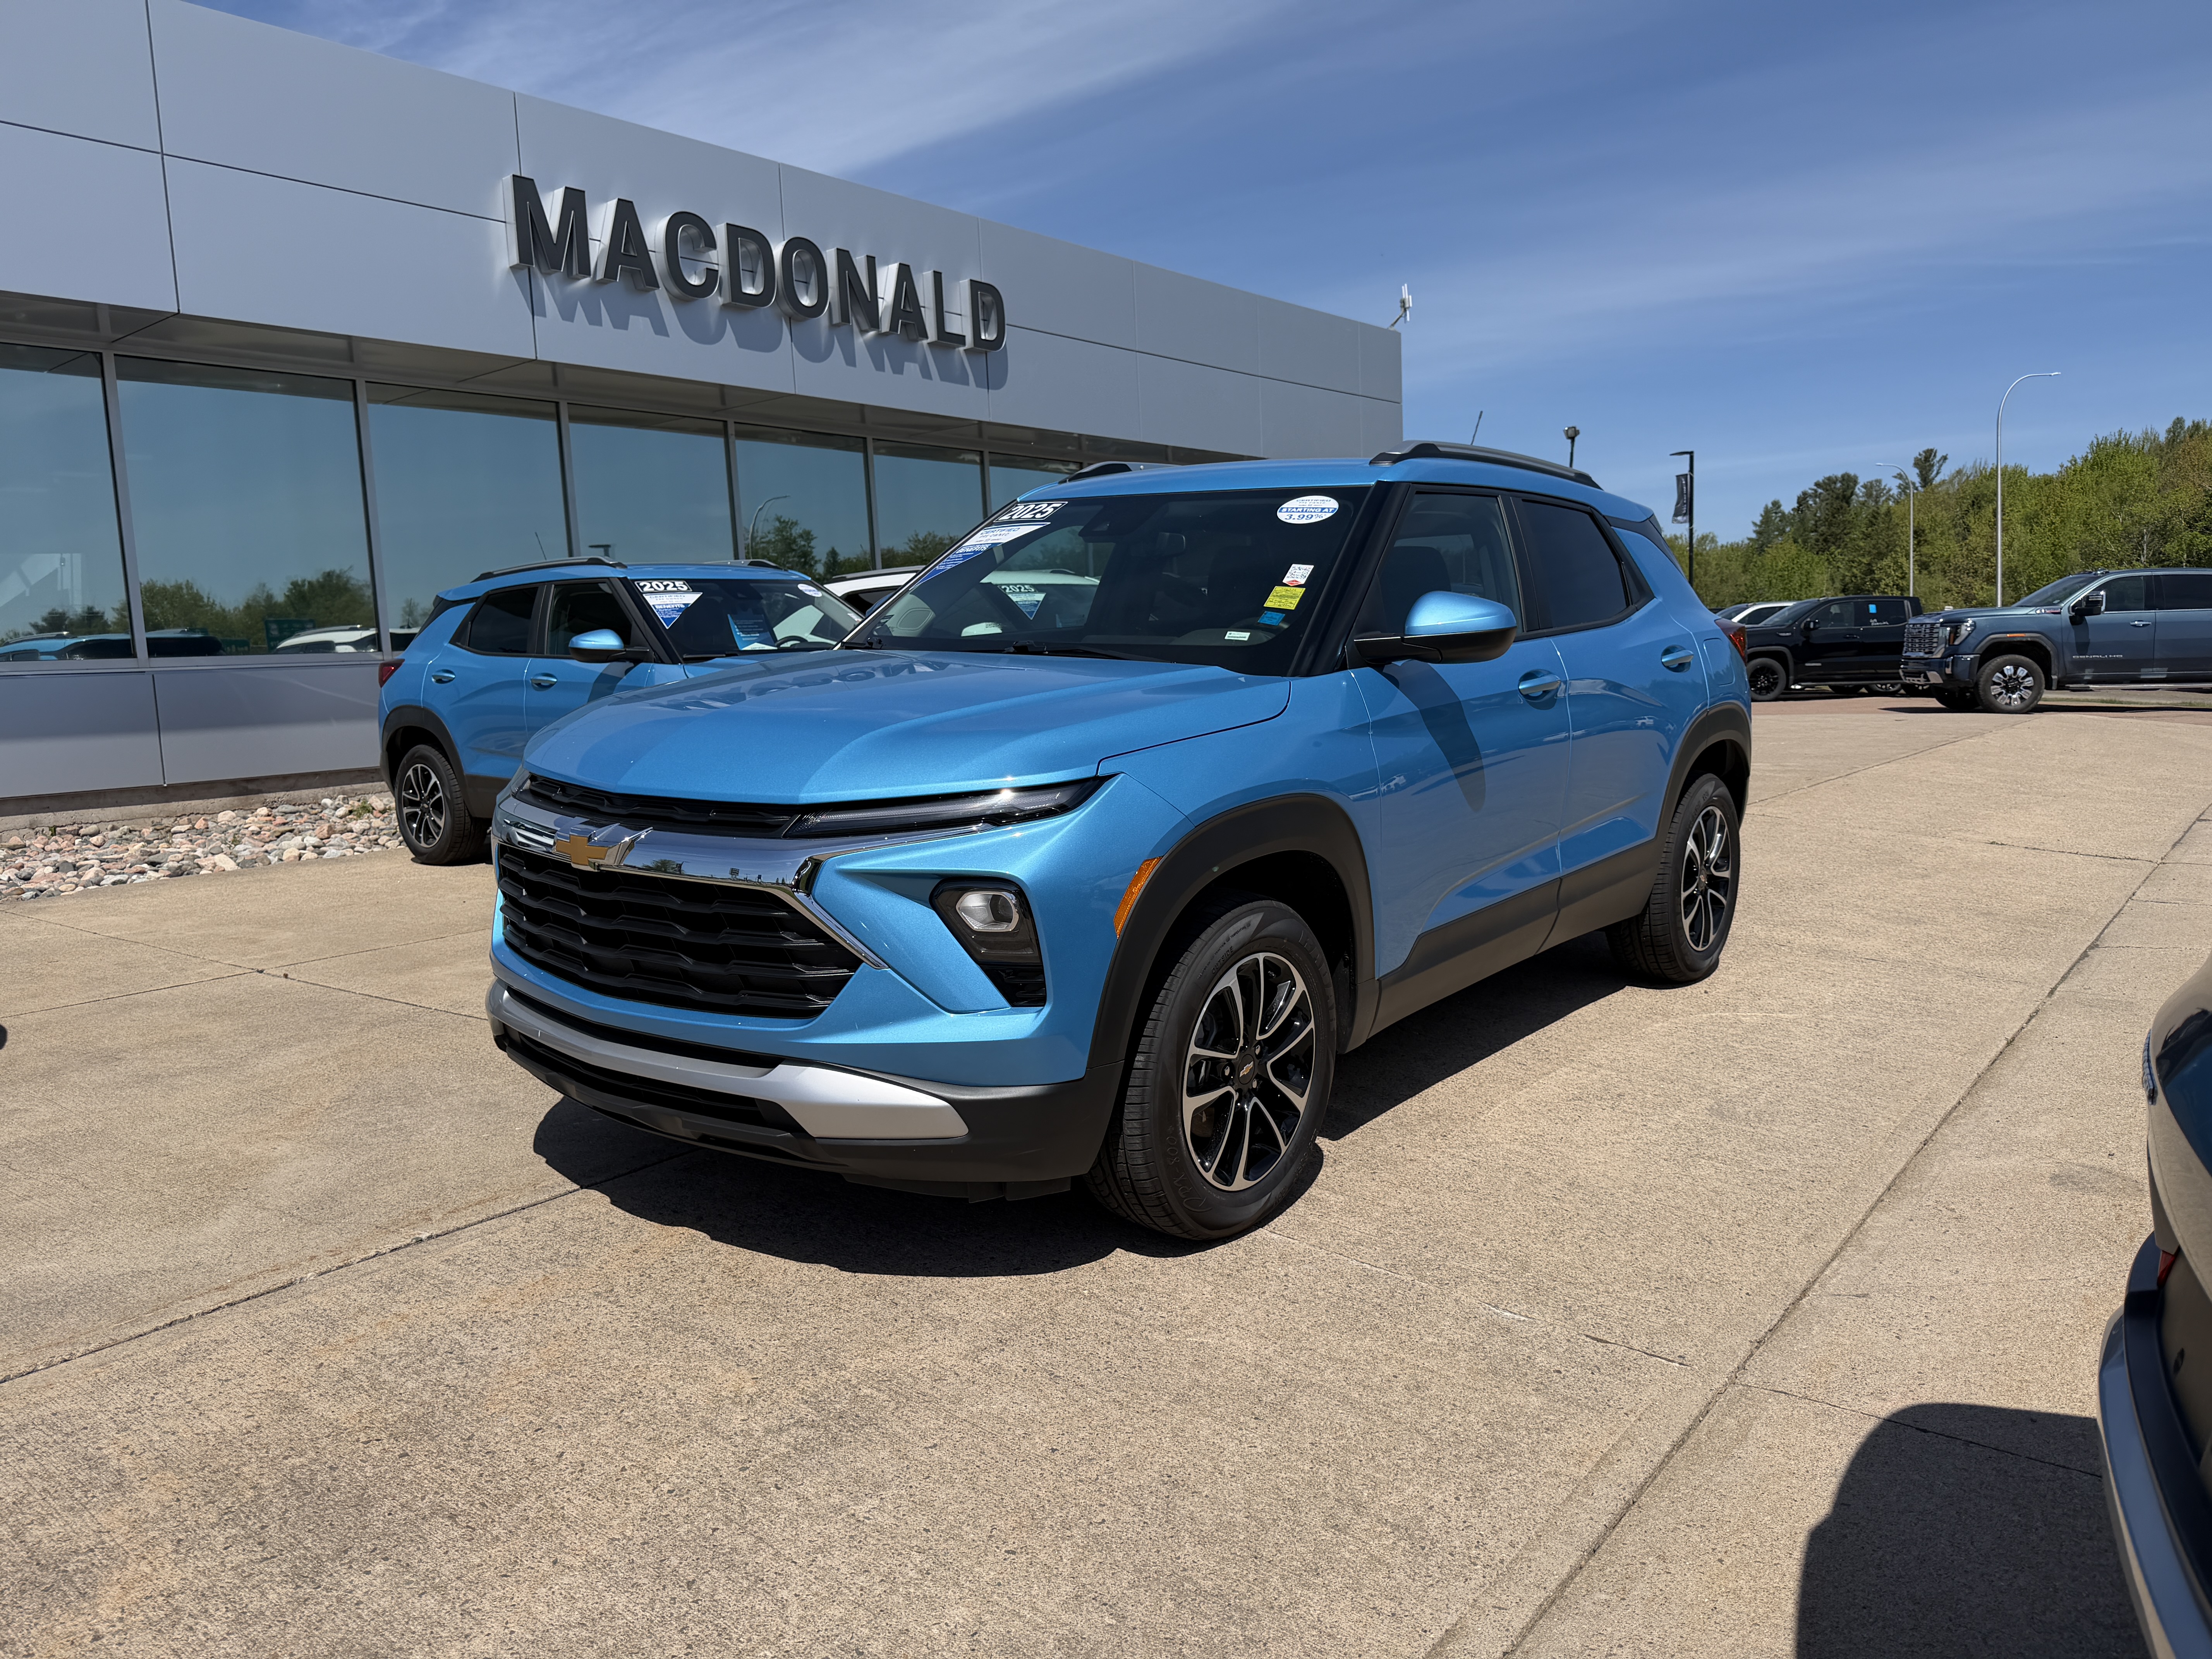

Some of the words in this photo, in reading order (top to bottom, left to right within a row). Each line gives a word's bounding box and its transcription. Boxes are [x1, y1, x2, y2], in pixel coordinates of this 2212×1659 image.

[507, 173, 1007, 352] MACDONALD
[998, 503, 1062, 520] 2025
[639, 581, 688, 592] 2025
[1001, 585, 1035, 593] 2025
[1211, 946, 1234, 975] OUTSIDE
